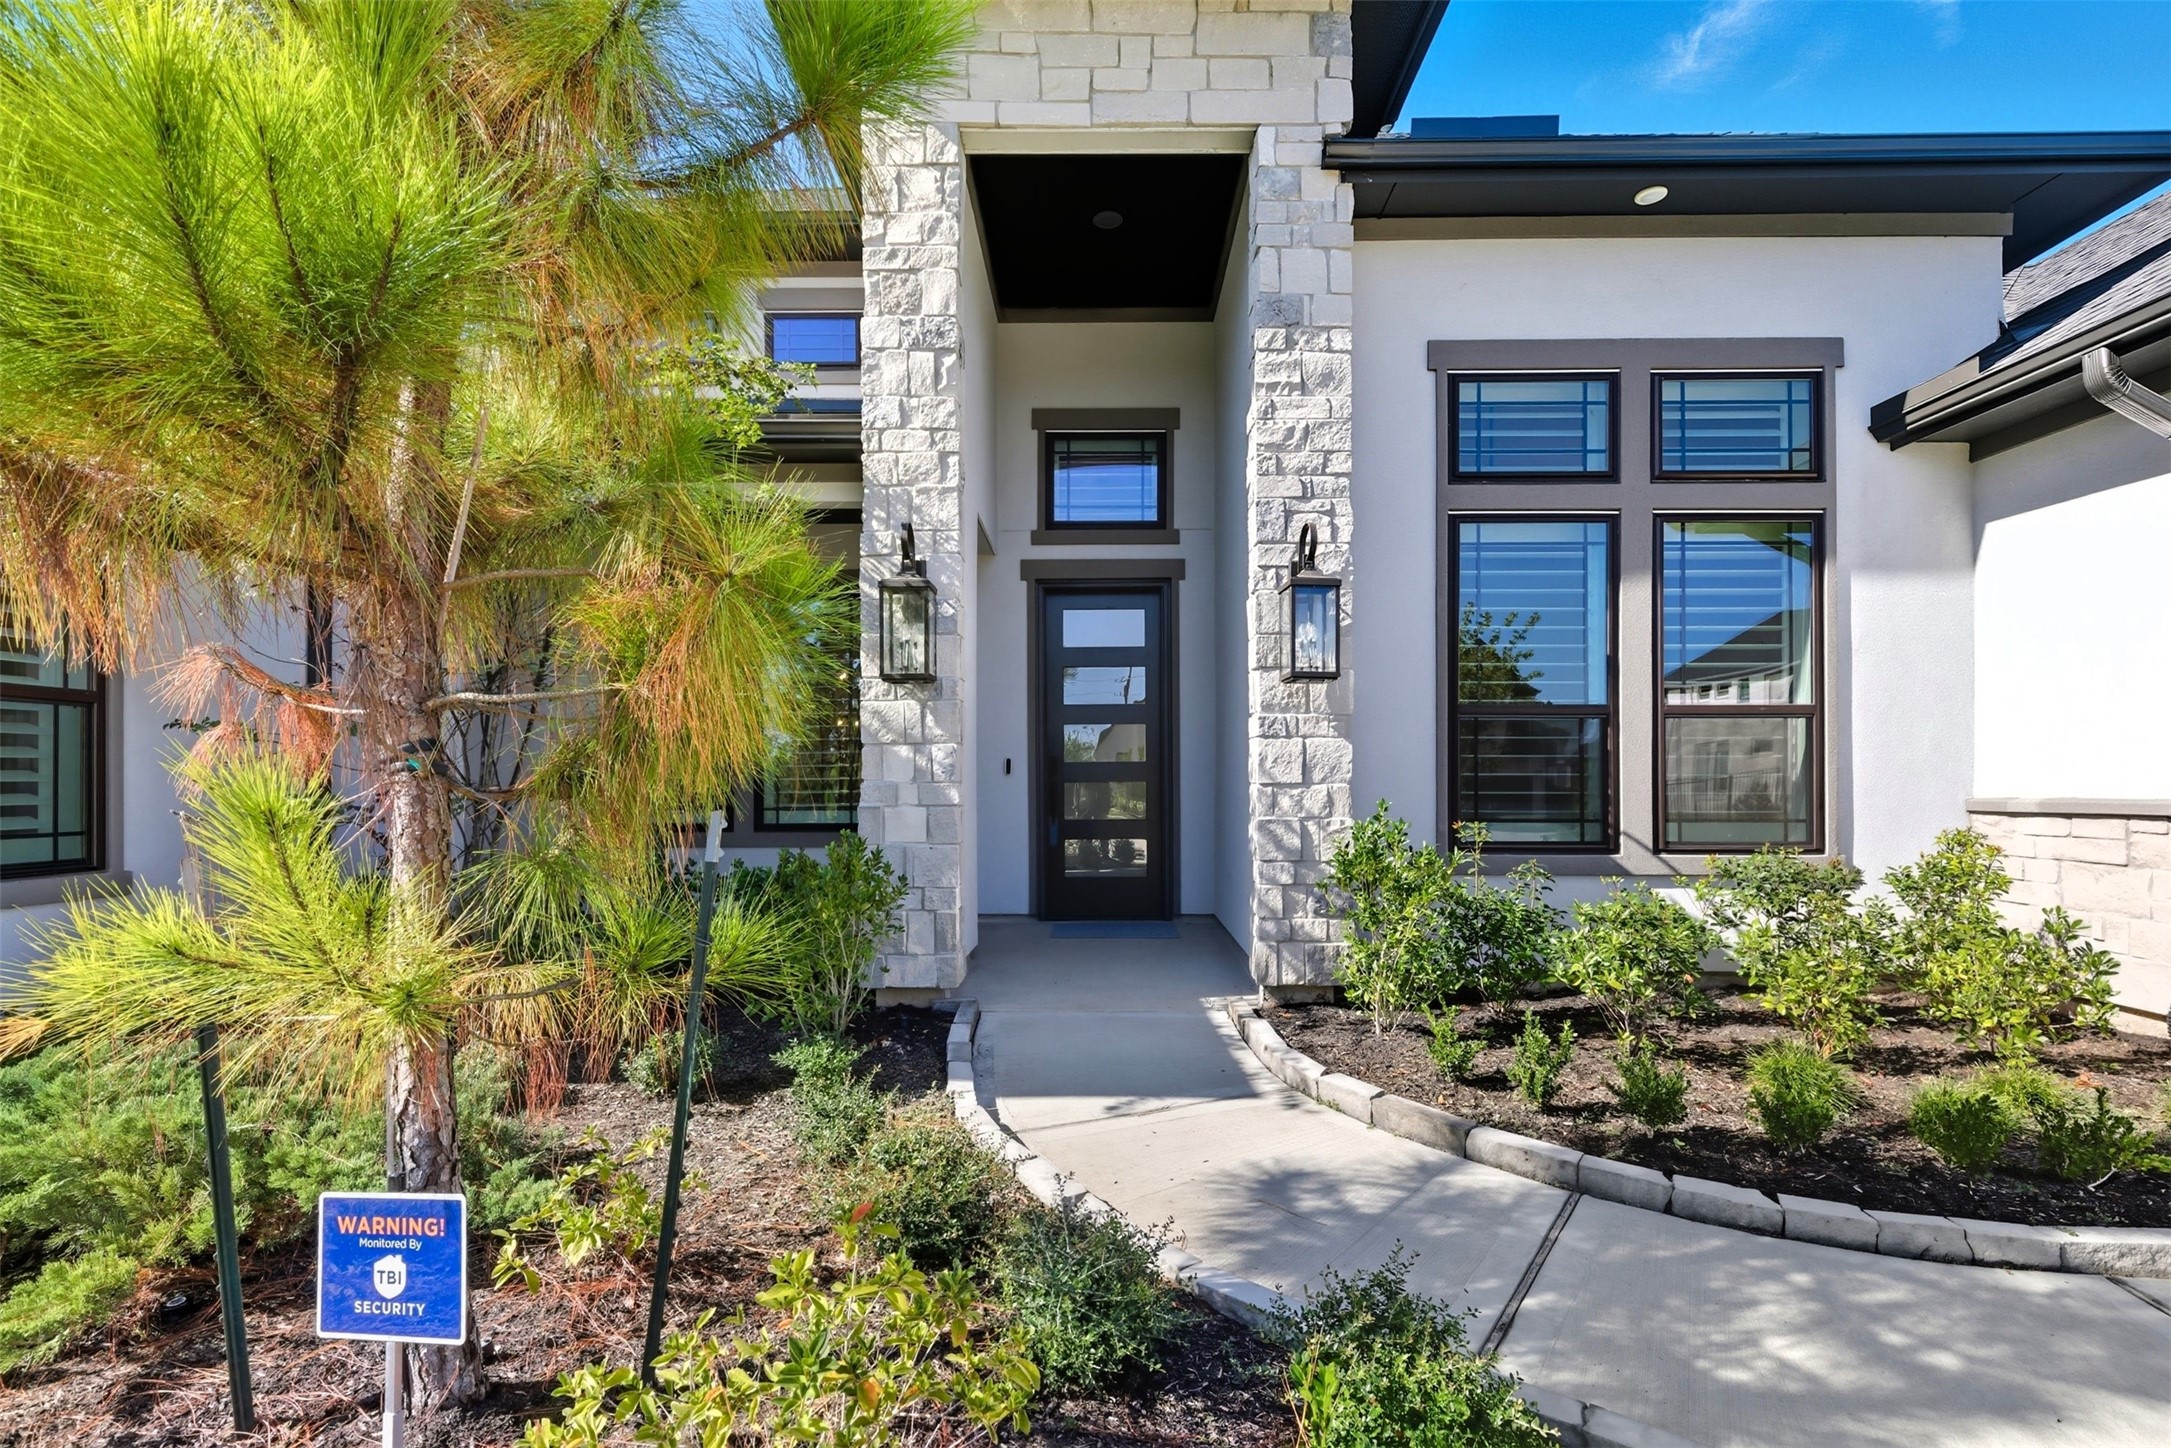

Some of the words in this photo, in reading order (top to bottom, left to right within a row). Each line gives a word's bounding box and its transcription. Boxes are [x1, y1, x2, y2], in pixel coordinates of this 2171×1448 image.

[337, 1216, 445, 1236] WARNING!
[359, 1238, 407, 1249] Monitored
[409, 1239, 422, 1251] By
[377, 1270, 401, 1285] TBI
[354, 1301, 425, 1316] SECURITY
